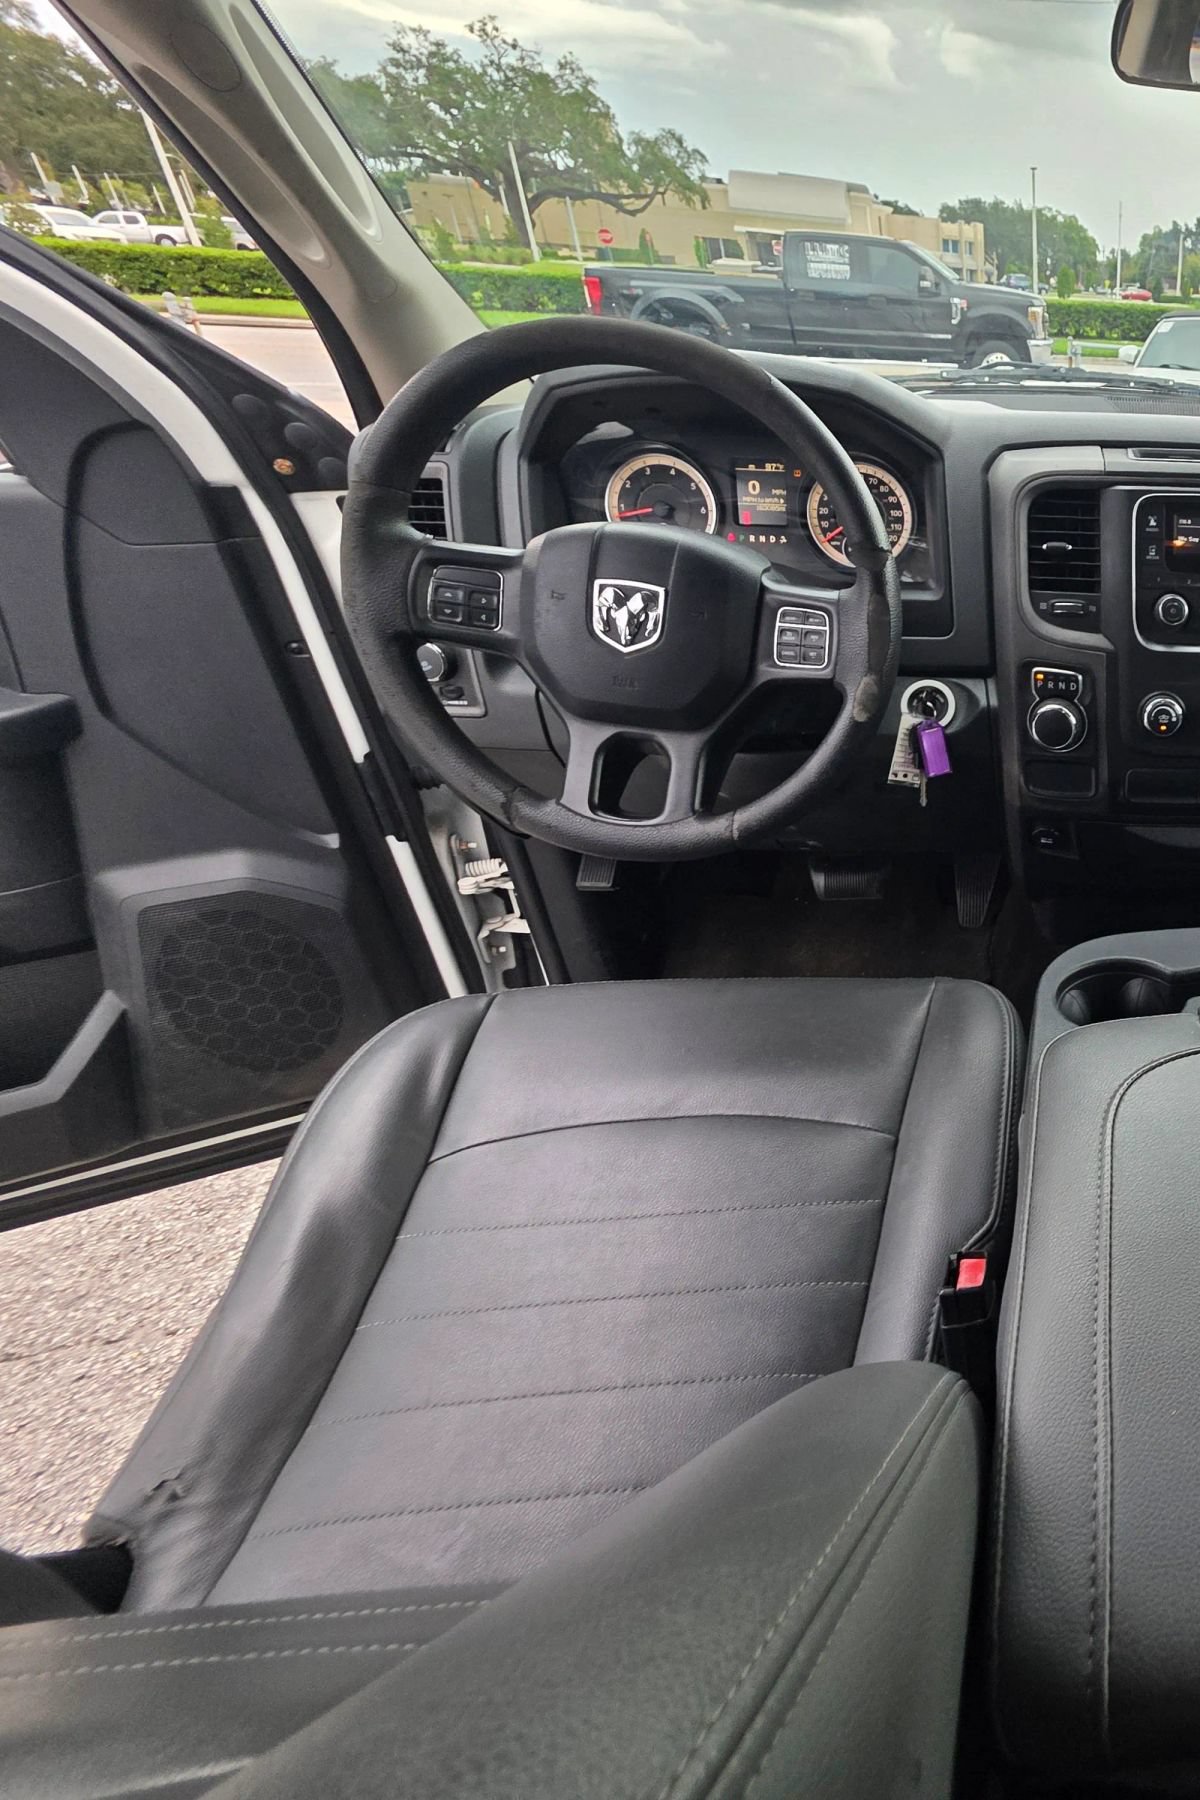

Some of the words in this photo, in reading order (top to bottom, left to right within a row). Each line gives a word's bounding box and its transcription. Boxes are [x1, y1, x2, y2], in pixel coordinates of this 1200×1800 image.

[644, 467, 650, 475] 3
[669, 467, 676, 476] 4
[690, 482, 696, 490] 5
[748, 480, 760, 495] 0
[700, 506, 706, 514] 6
[820, 520, 829, 528] 10
[1037, 680, 1044, 688] P
[1048, 680, 1054, 688] R
[1058, 682, 1066, 690] N
